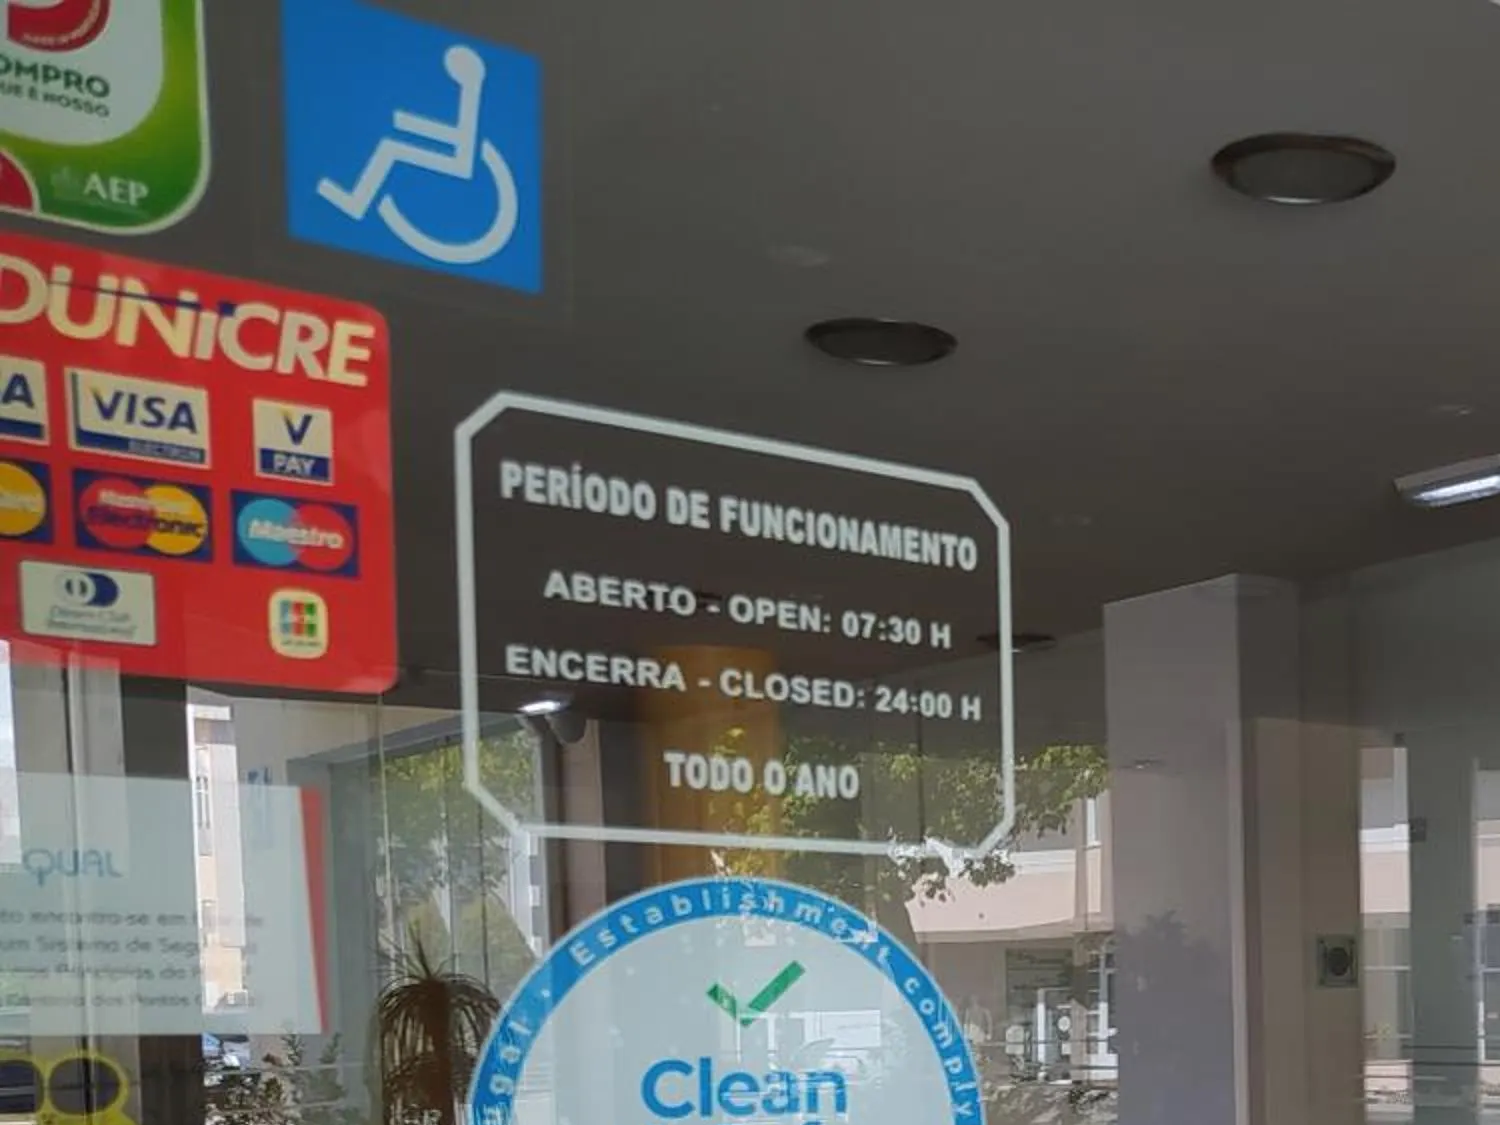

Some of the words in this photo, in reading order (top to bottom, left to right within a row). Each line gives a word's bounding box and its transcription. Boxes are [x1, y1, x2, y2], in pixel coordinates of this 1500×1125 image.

[83, 171, 149, 206] AEP
[92, 386, 197, 434] VISA
[273, 454, 316, 478] PAY
[248, 518, 345, 551] Maestro
[501, 460, 657, 522] PERÍODO
[667, 486, 710, 530] DE
[720, 495, 977, 572] FUNCIONAMENTO
[543, 569, 697, 616] ABERTO
[728, 594, 832, 634] OPEN:
[842, 611, 922, 645] 07:30
[930, 622, 951, 649] H
[505, 644, 685, 691] ENCERRA
[719, 668, 866, 709] CLOSED:
[875, 685, 952, 719] 24:00
[961, 696, 981, 720] H
[664, 751, 753, 795] TODO
[764, 758, 783, 794] O
[795, 760, 859, 799] ANO
[570, 885, 892, 968] Establishment
[641, 1056, 848, 1119] Clean
